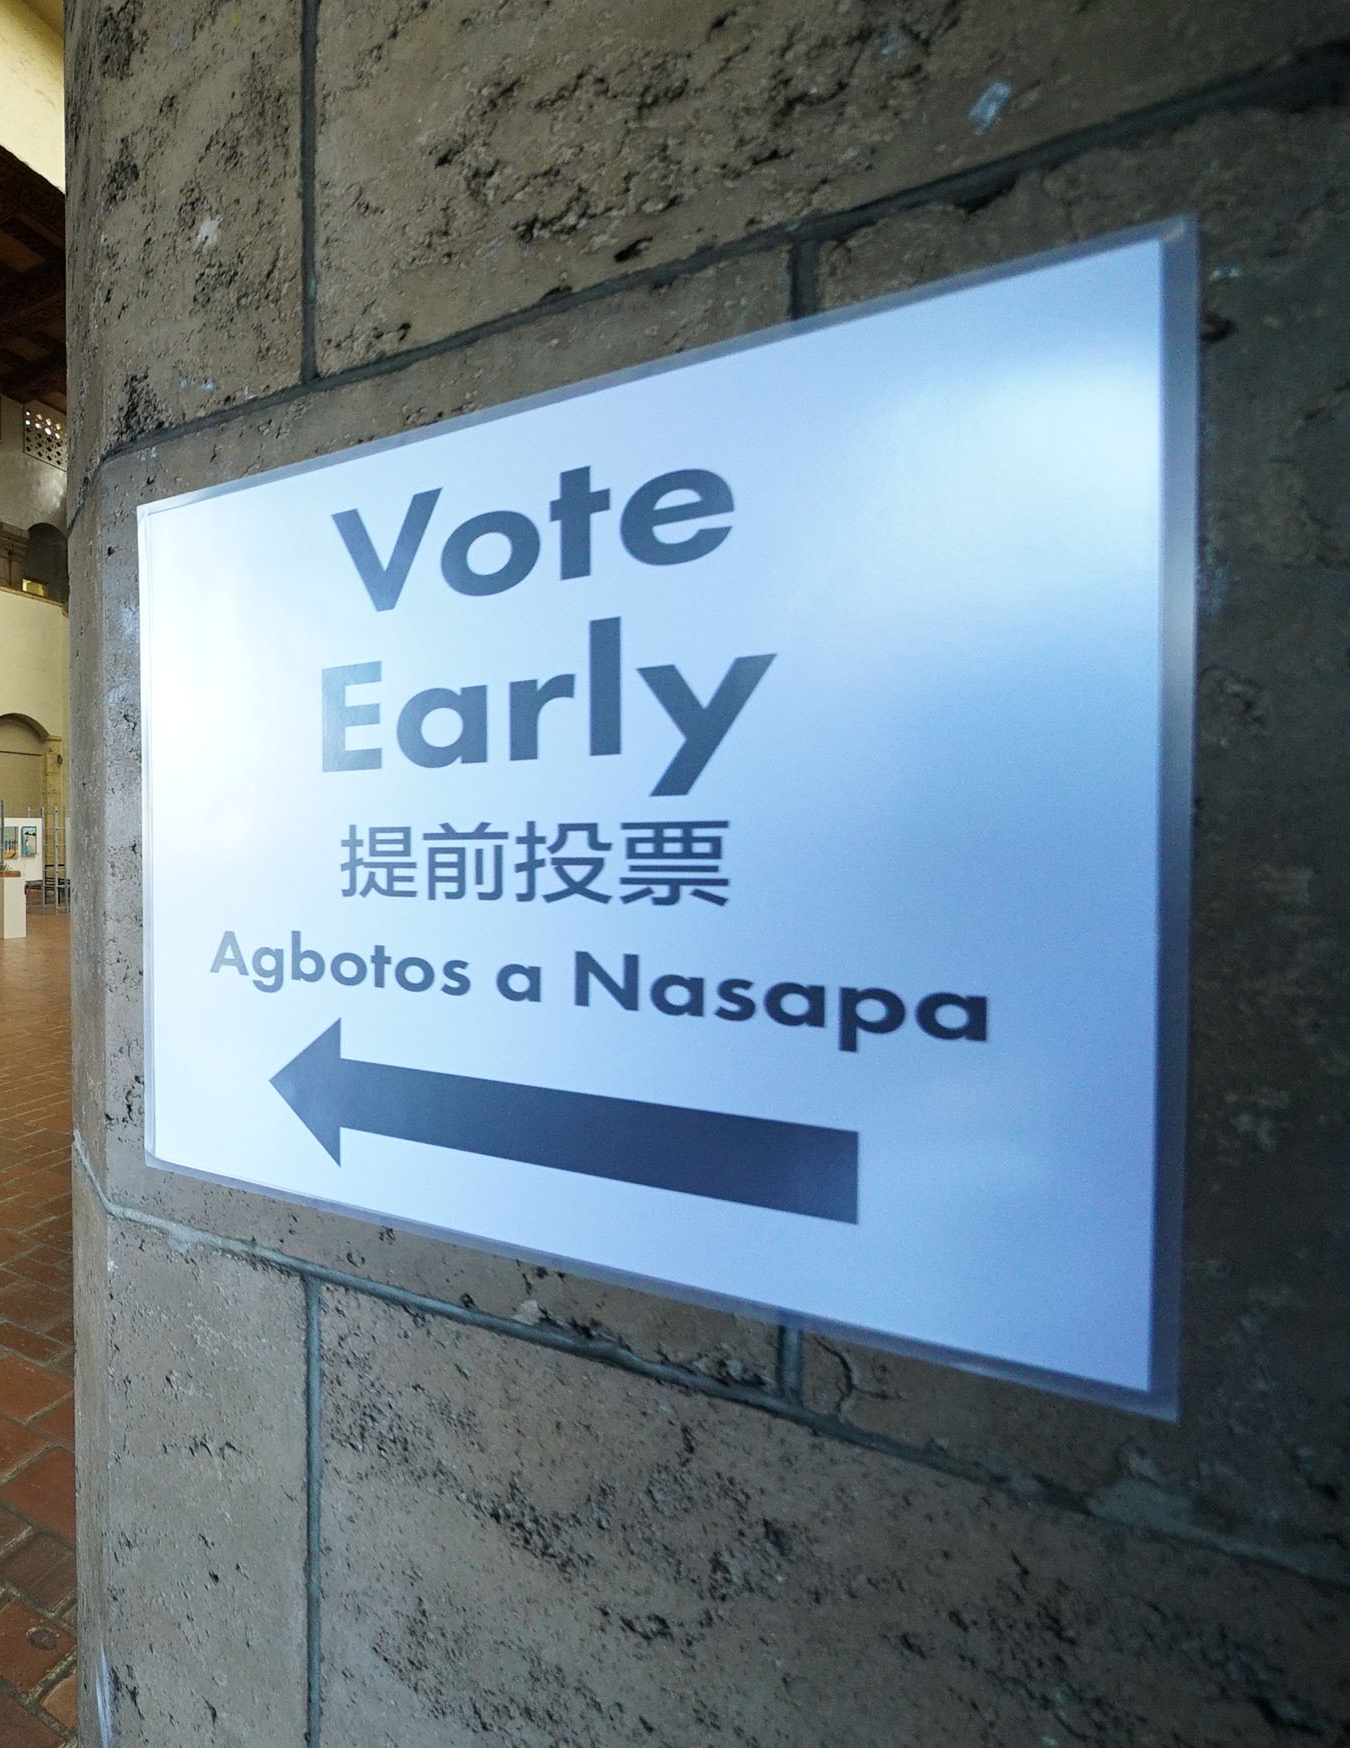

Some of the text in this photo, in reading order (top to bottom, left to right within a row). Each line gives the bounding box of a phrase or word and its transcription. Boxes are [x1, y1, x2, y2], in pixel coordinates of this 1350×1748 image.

[331, 467, 735, 611] Vote
[322, 616, 776, 797] Early
[339, 820, 730, 906] 提前投票
[210, 931, 989, 1053] Agbotos a Nasapa
